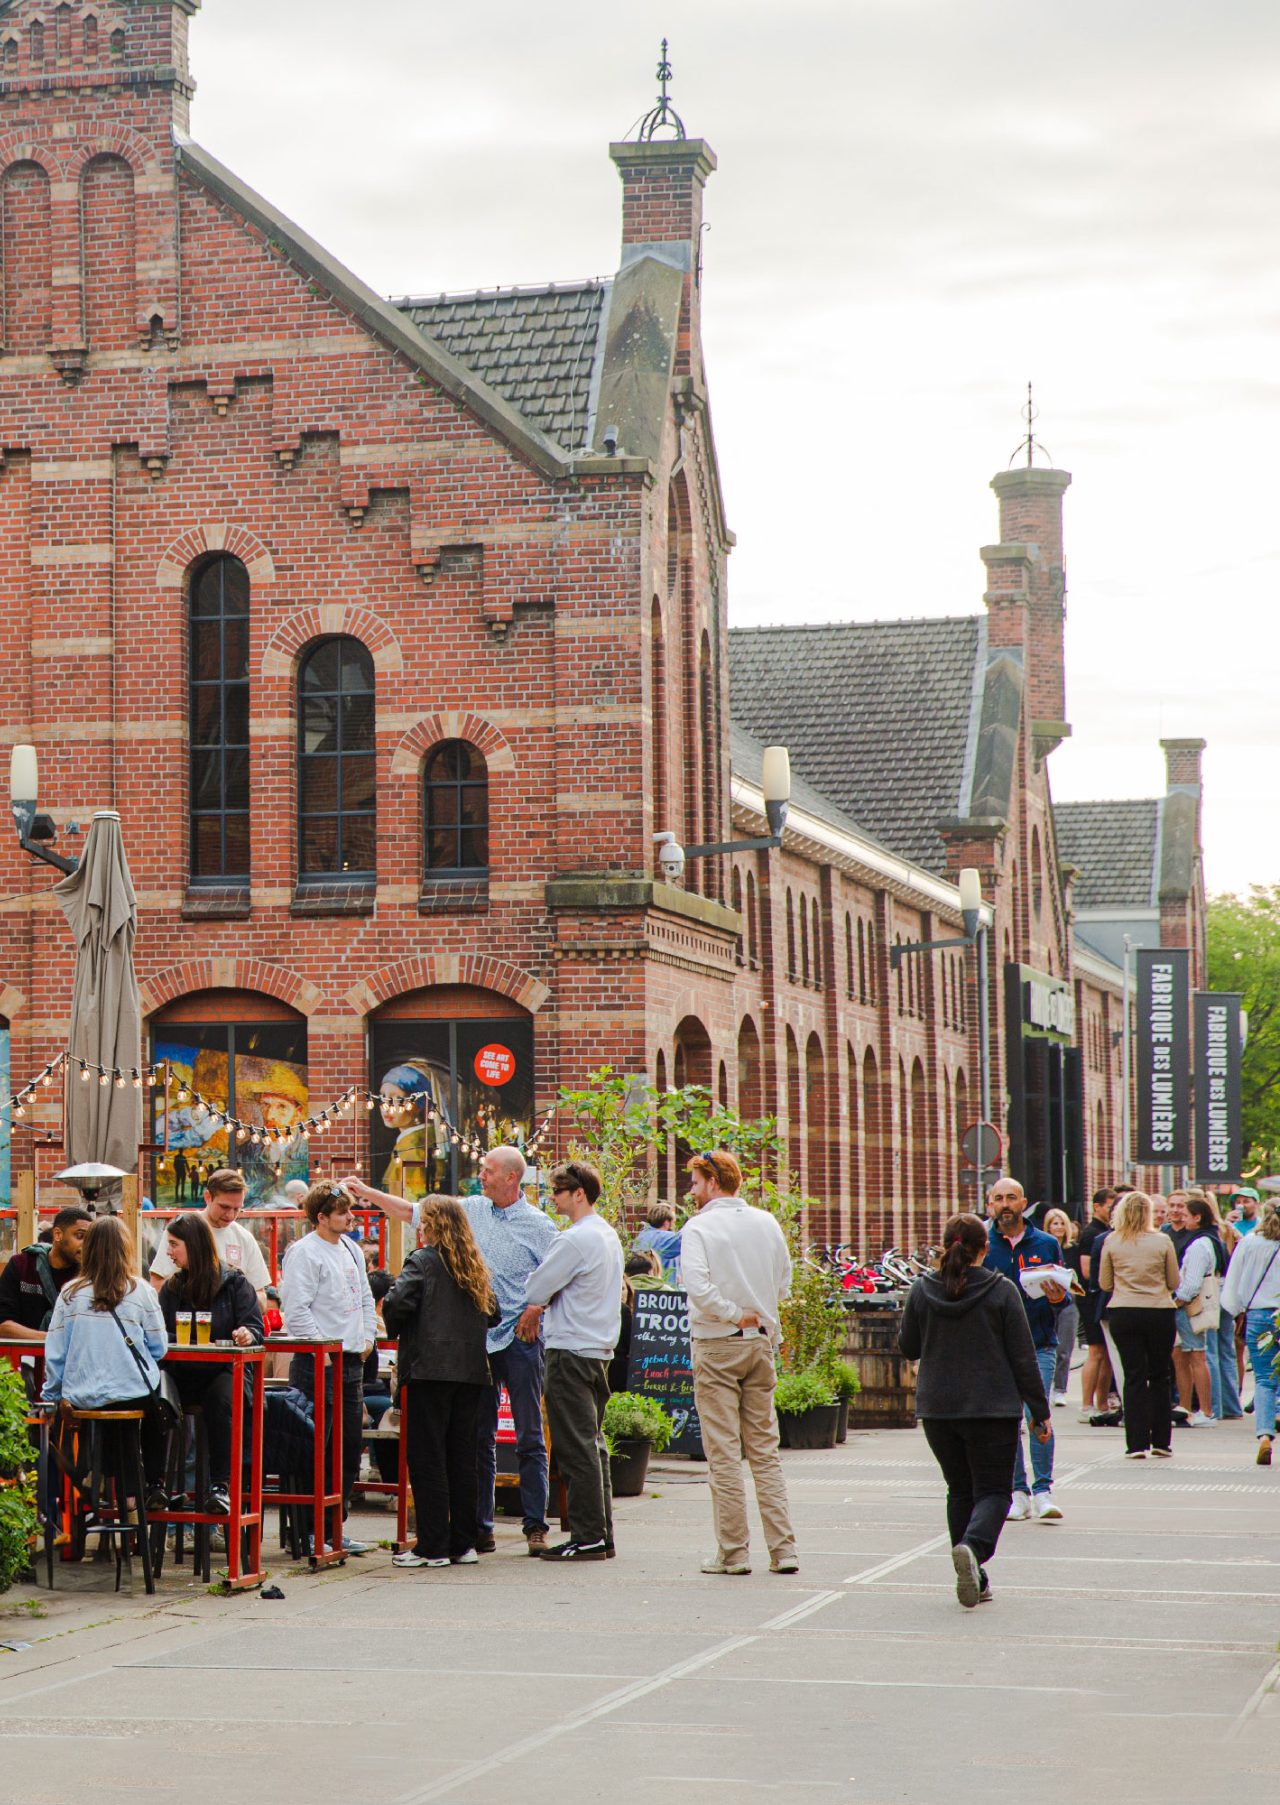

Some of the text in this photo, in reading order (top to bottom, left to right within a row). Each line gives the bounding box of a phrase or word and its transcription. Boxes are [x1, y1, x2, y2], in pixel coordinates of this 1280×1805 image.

[483, 1050, 510, 1062] SEE ART
[1150, 964, 1177, 1152] FABRIQUE DES LUMIÈRES
[480, 1060, 510, 1072] COME TO
[486, 1070, 500, 1079] LIFE
[1206, 1006, 1231, 1172] FABRIQUE DES LUMIÈRES
[638, 1293, 688, 1311] BROUW
[642, 1354, 669, 1369] gebak
[644, 1368, 669, 1378] Lunch
